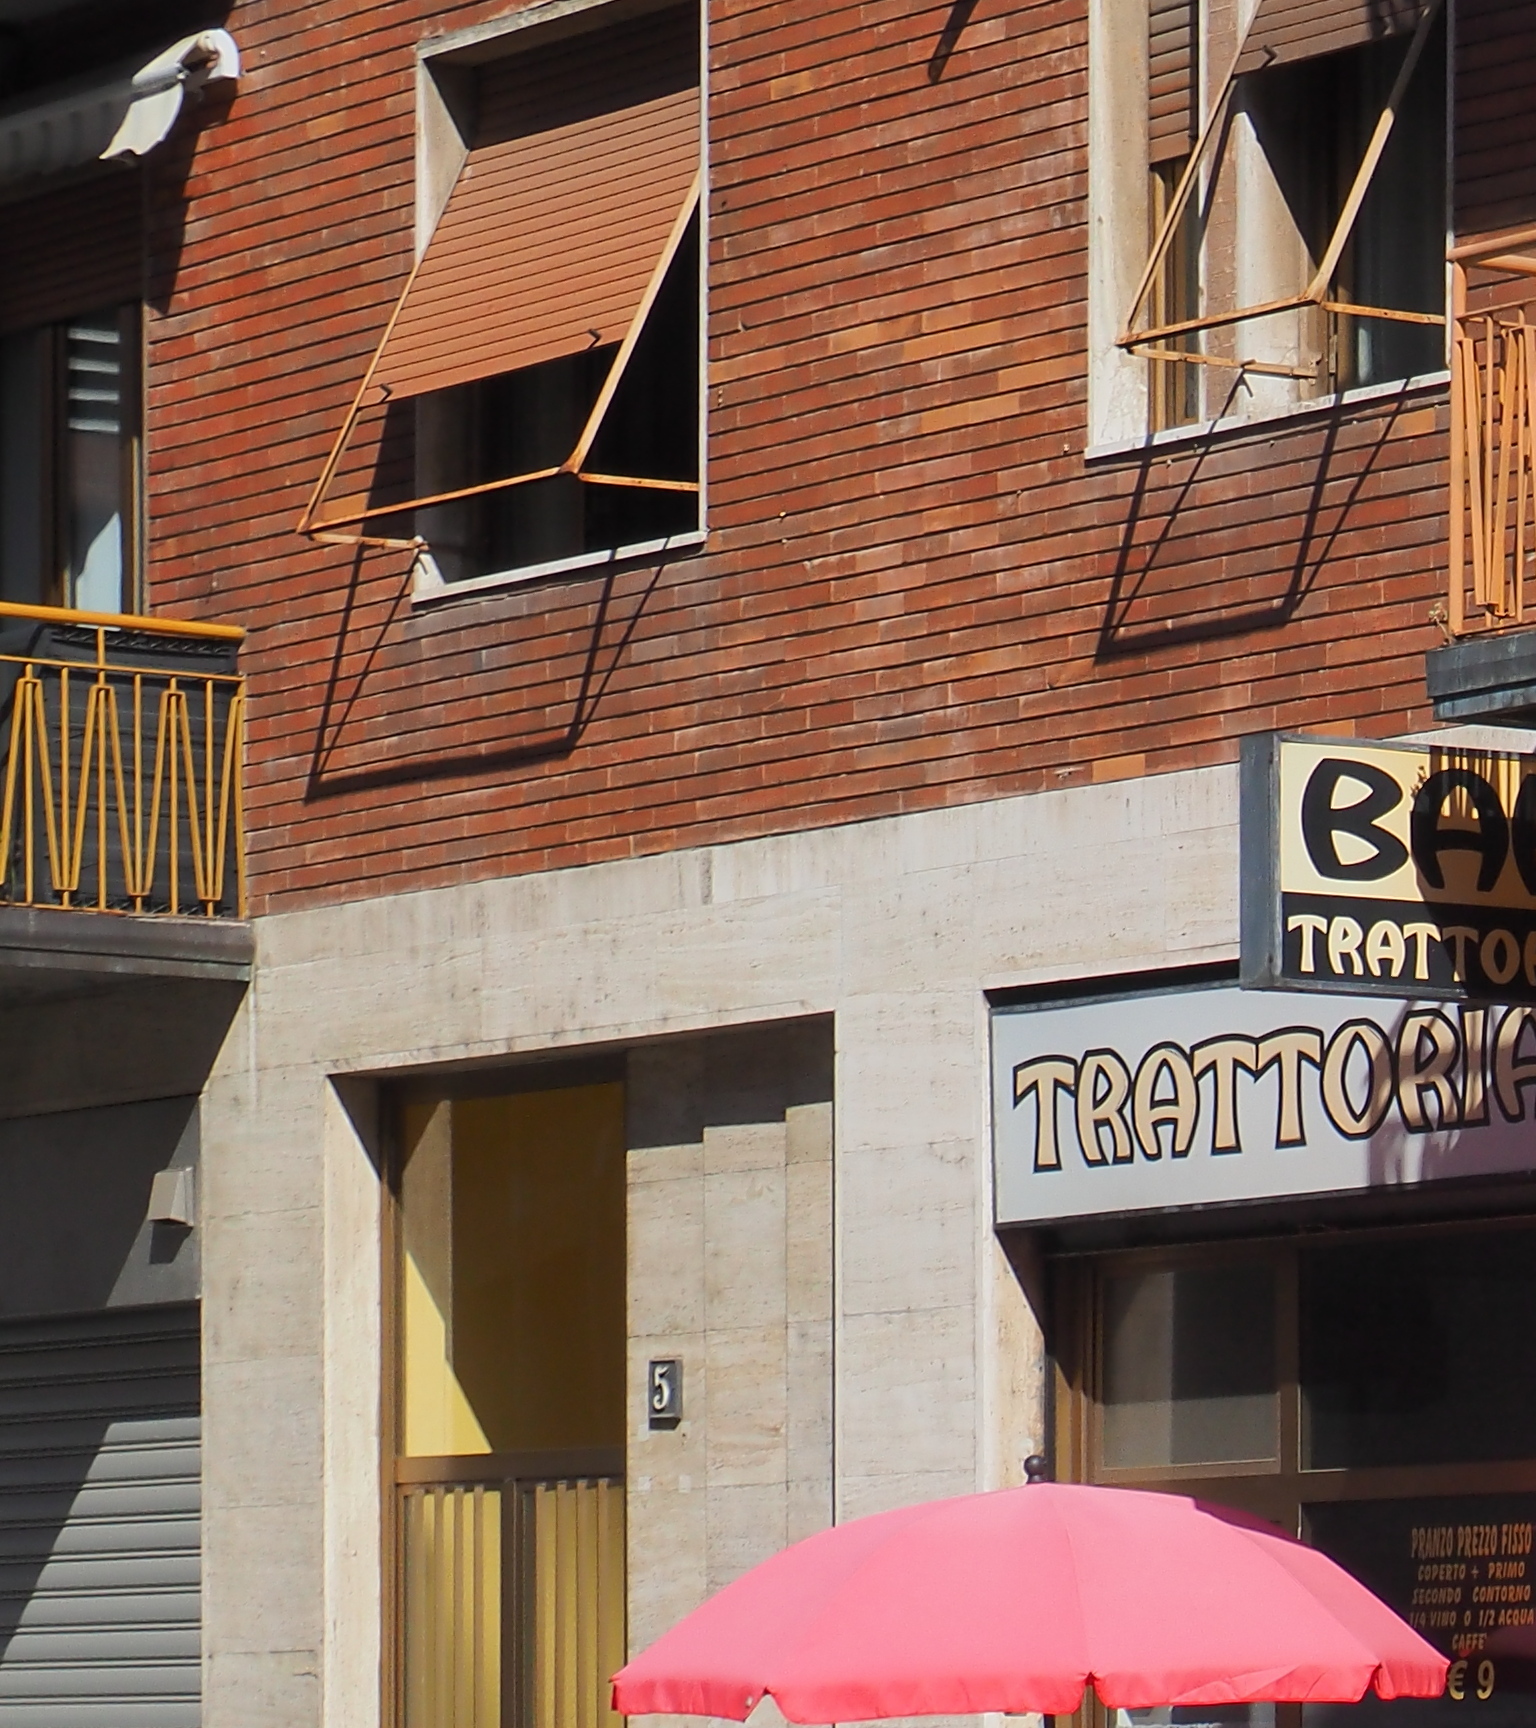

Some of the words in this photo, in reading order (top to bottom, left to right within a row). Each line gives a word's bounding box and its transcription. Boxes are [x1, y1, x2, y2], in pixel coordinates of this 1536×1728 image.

[653, 1365, 670, 1410] 5
[1411, 1526, 1453, 1559] PRANZO
[1457, 1524, 1497, 1557] PREZZO
[1501, 1522, 1532, 1556] FISSO
[1417, 1564, 1466, 1581] COPERTO
[1488, 1561, 1525, 1579] PRIMO
[1412, 1587, 1461, 1605] SECONDO
[1472, 1585, 1531, 1603] CONTORNO
[1478, 1609, 1495, 1626] 1/2
[1498, 1609, 1535, 1626] ACQUA
[1476, 1659, 1495, 1701] 9
